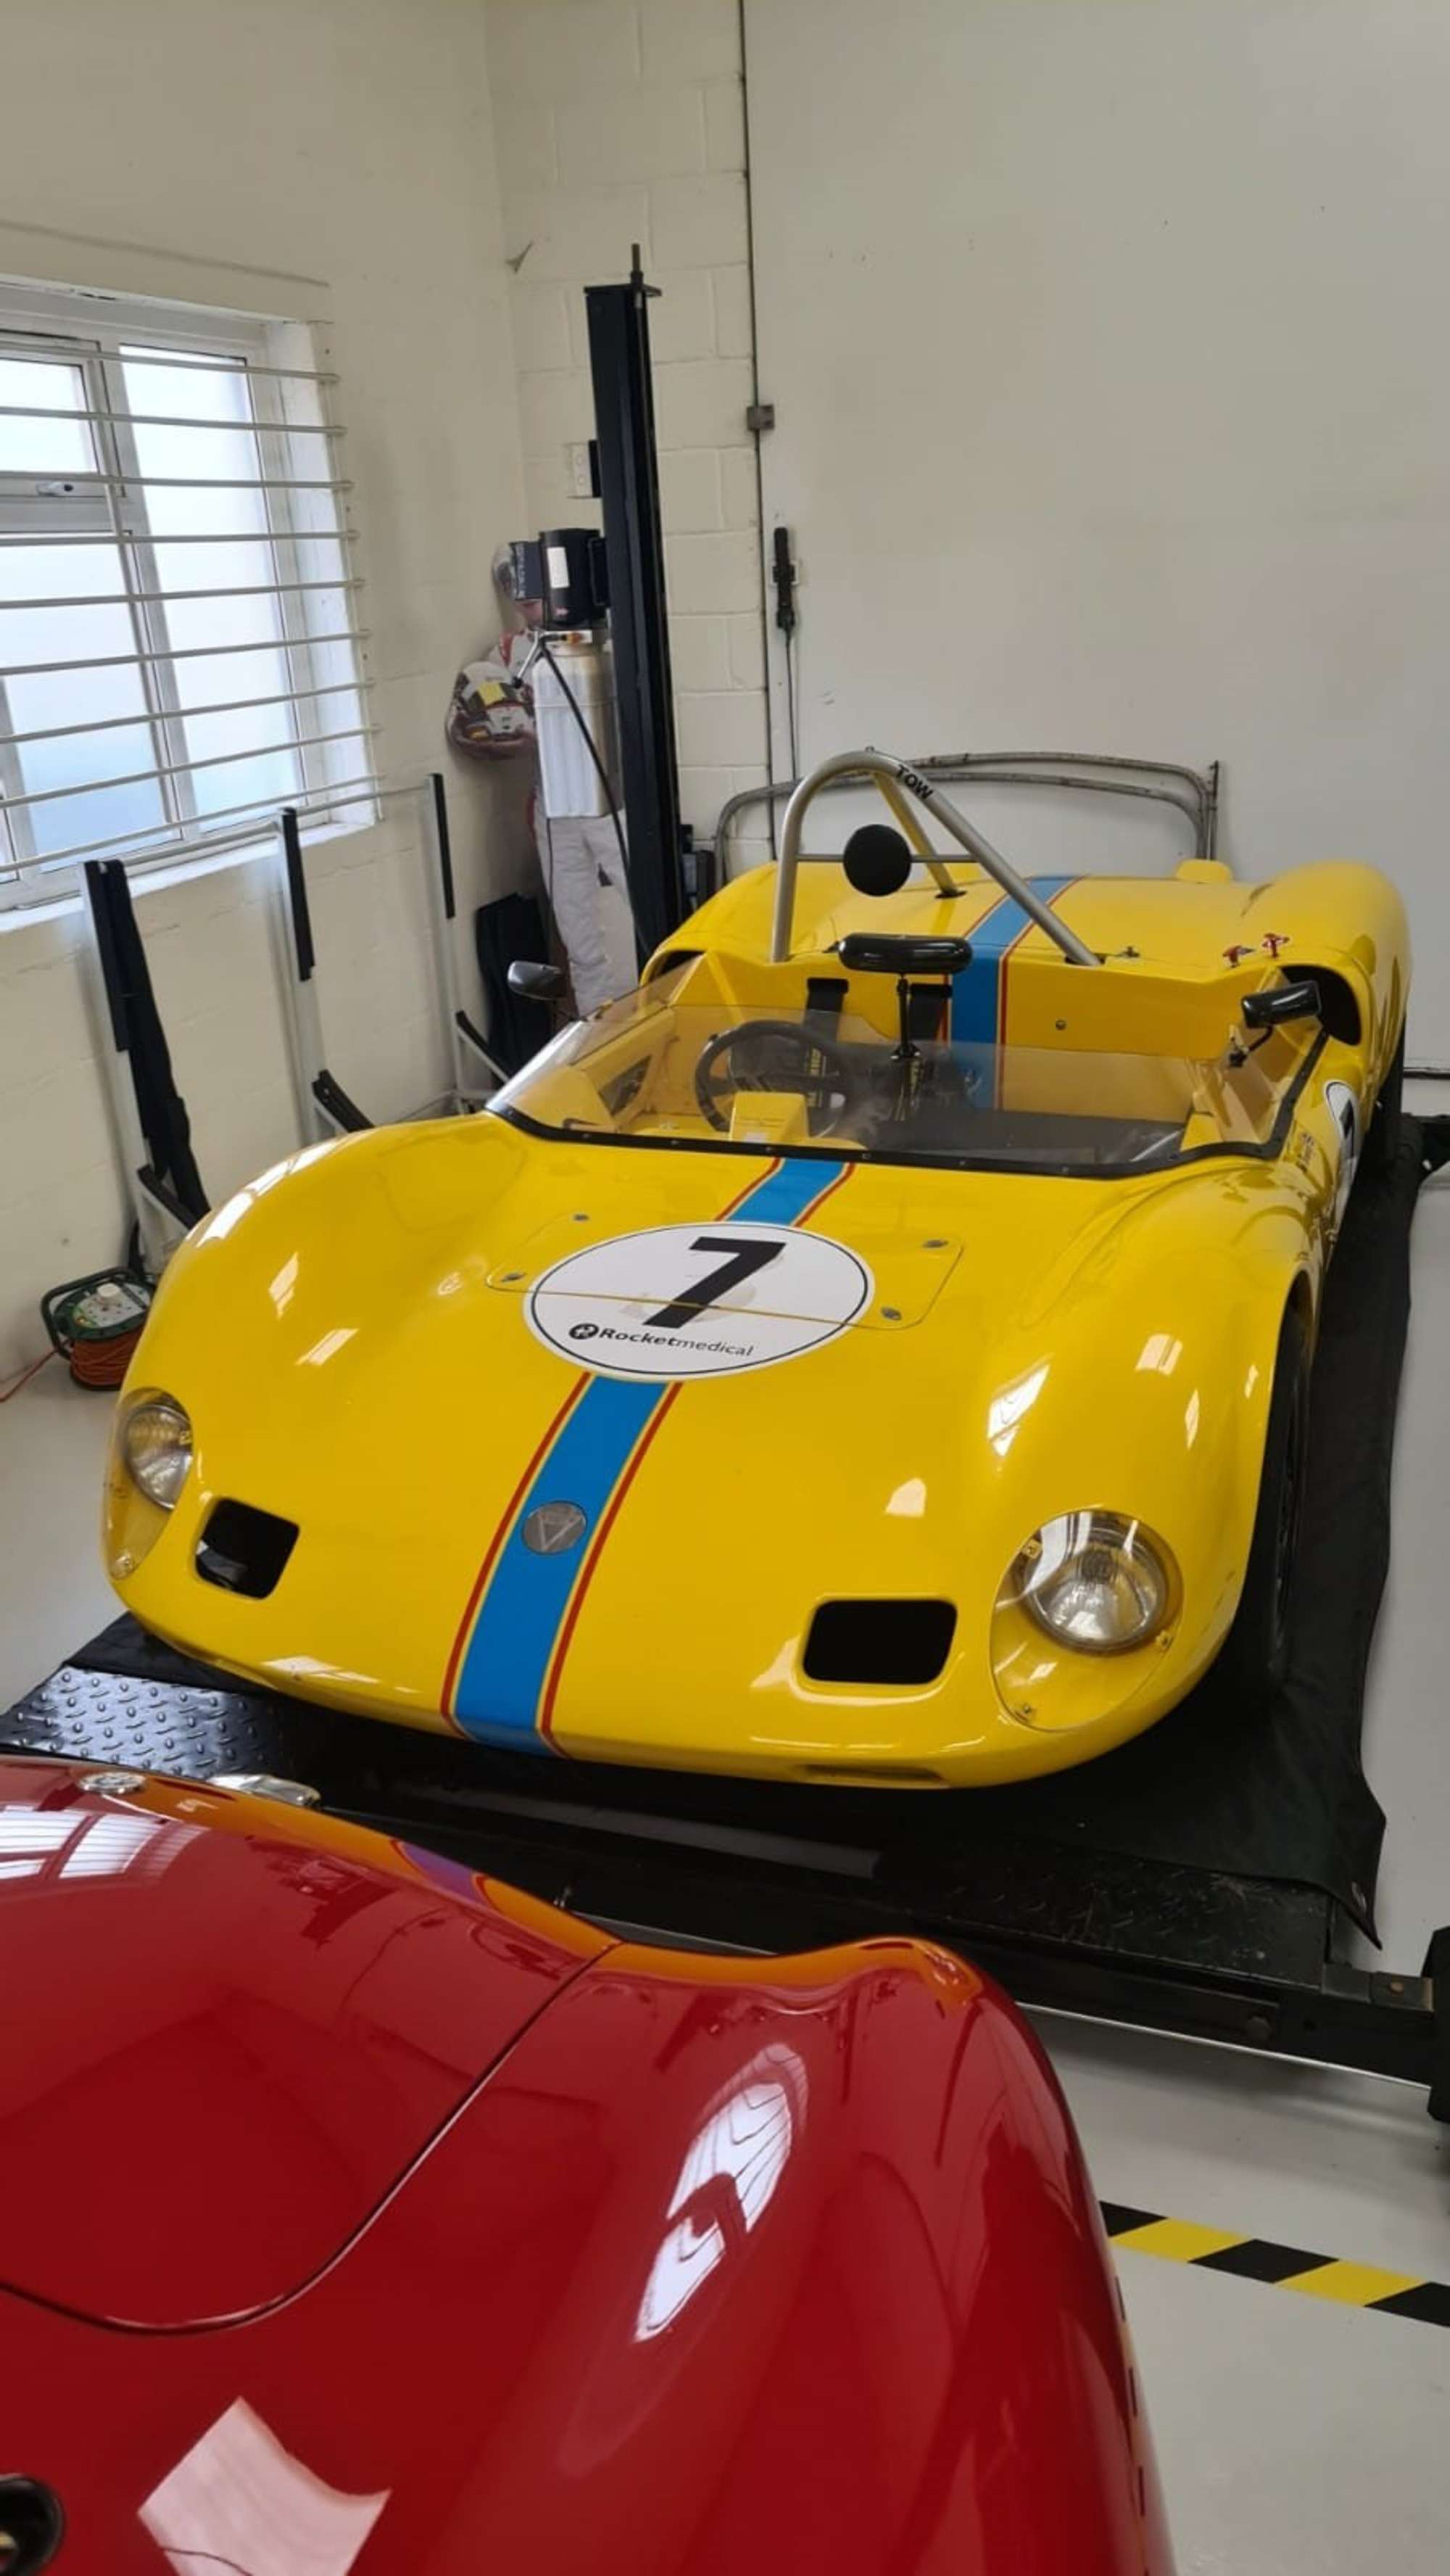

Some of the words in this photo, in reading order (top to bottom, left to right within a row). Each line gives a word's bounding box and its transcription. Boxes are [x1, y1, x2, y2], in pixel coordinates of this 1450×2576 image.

[896, 764, 933, 799] TOW
[642, 1237, 787, 1329] 7
[599, 1328, 753, 1356] Rocketmedical
